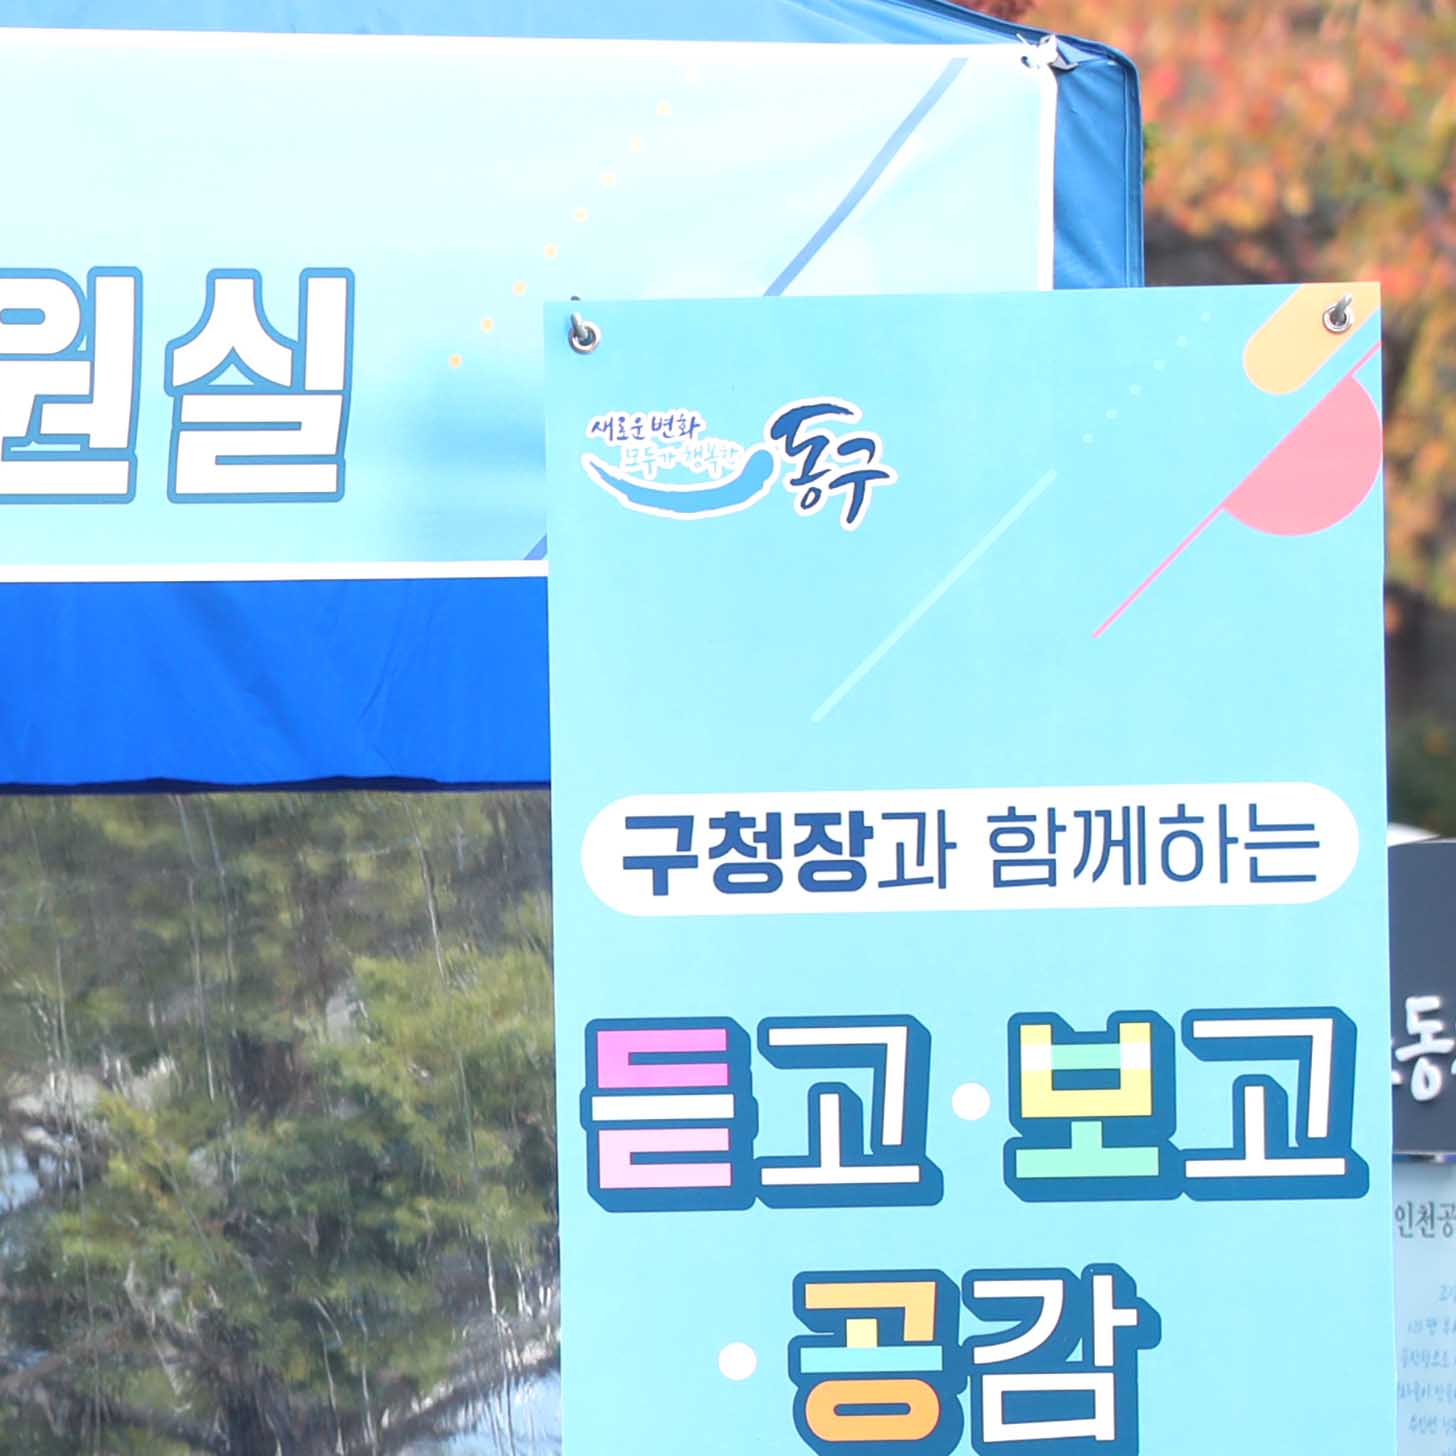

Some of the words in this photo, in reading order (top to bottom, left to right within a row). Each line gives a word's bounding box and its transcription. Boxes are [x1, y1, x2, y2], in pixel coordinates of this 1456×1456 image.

[591, 416, 645, 441] 새로운
[651, 415, 701, 441] 변화
[770, 403, 891, 524] 동구
[622, 809, 958, 897] 구청장과
[986, 804, 1321, 887] 함께하는
